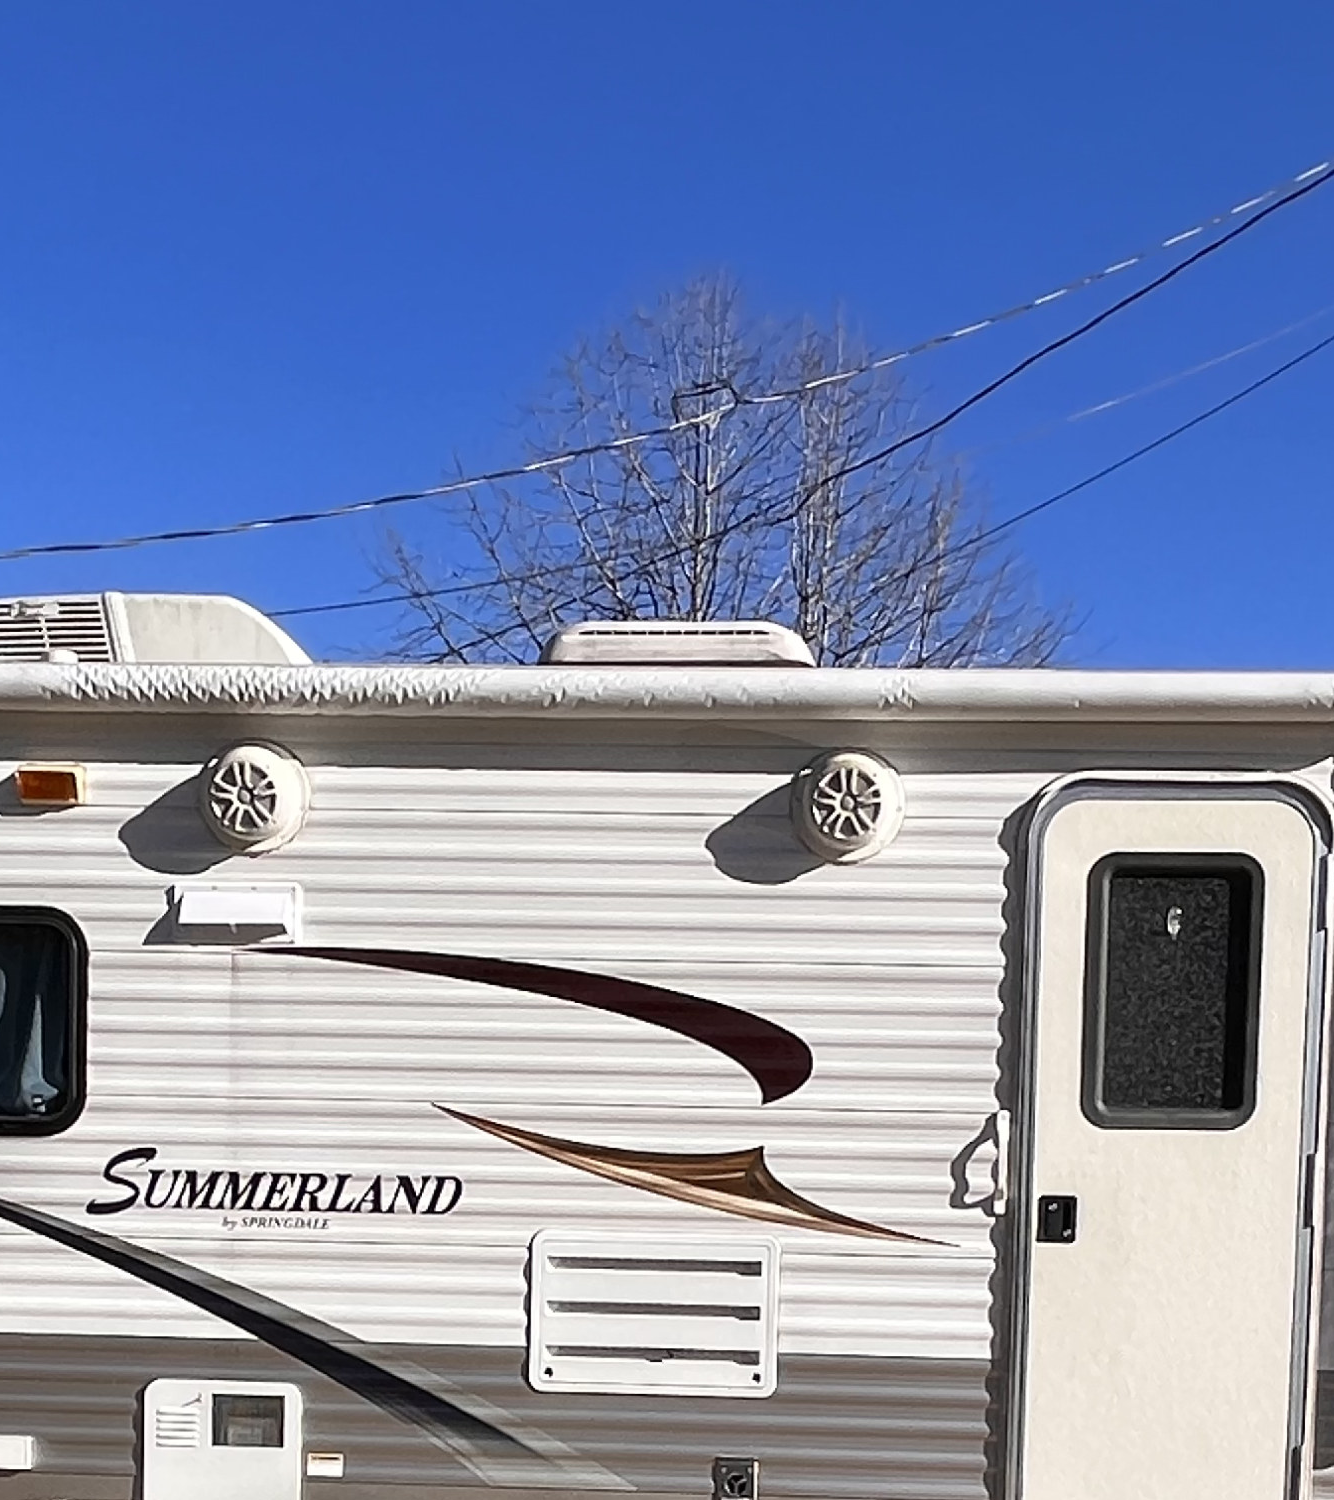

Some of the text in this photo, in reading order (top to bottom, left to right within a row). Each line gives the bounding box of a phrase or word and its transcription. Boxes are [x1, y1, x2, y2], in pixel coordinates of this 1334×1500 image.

[85, 1146, 464, 1216] SUMMERLAND
[222, 1216, 331, 1231] by SPRINGDALE
